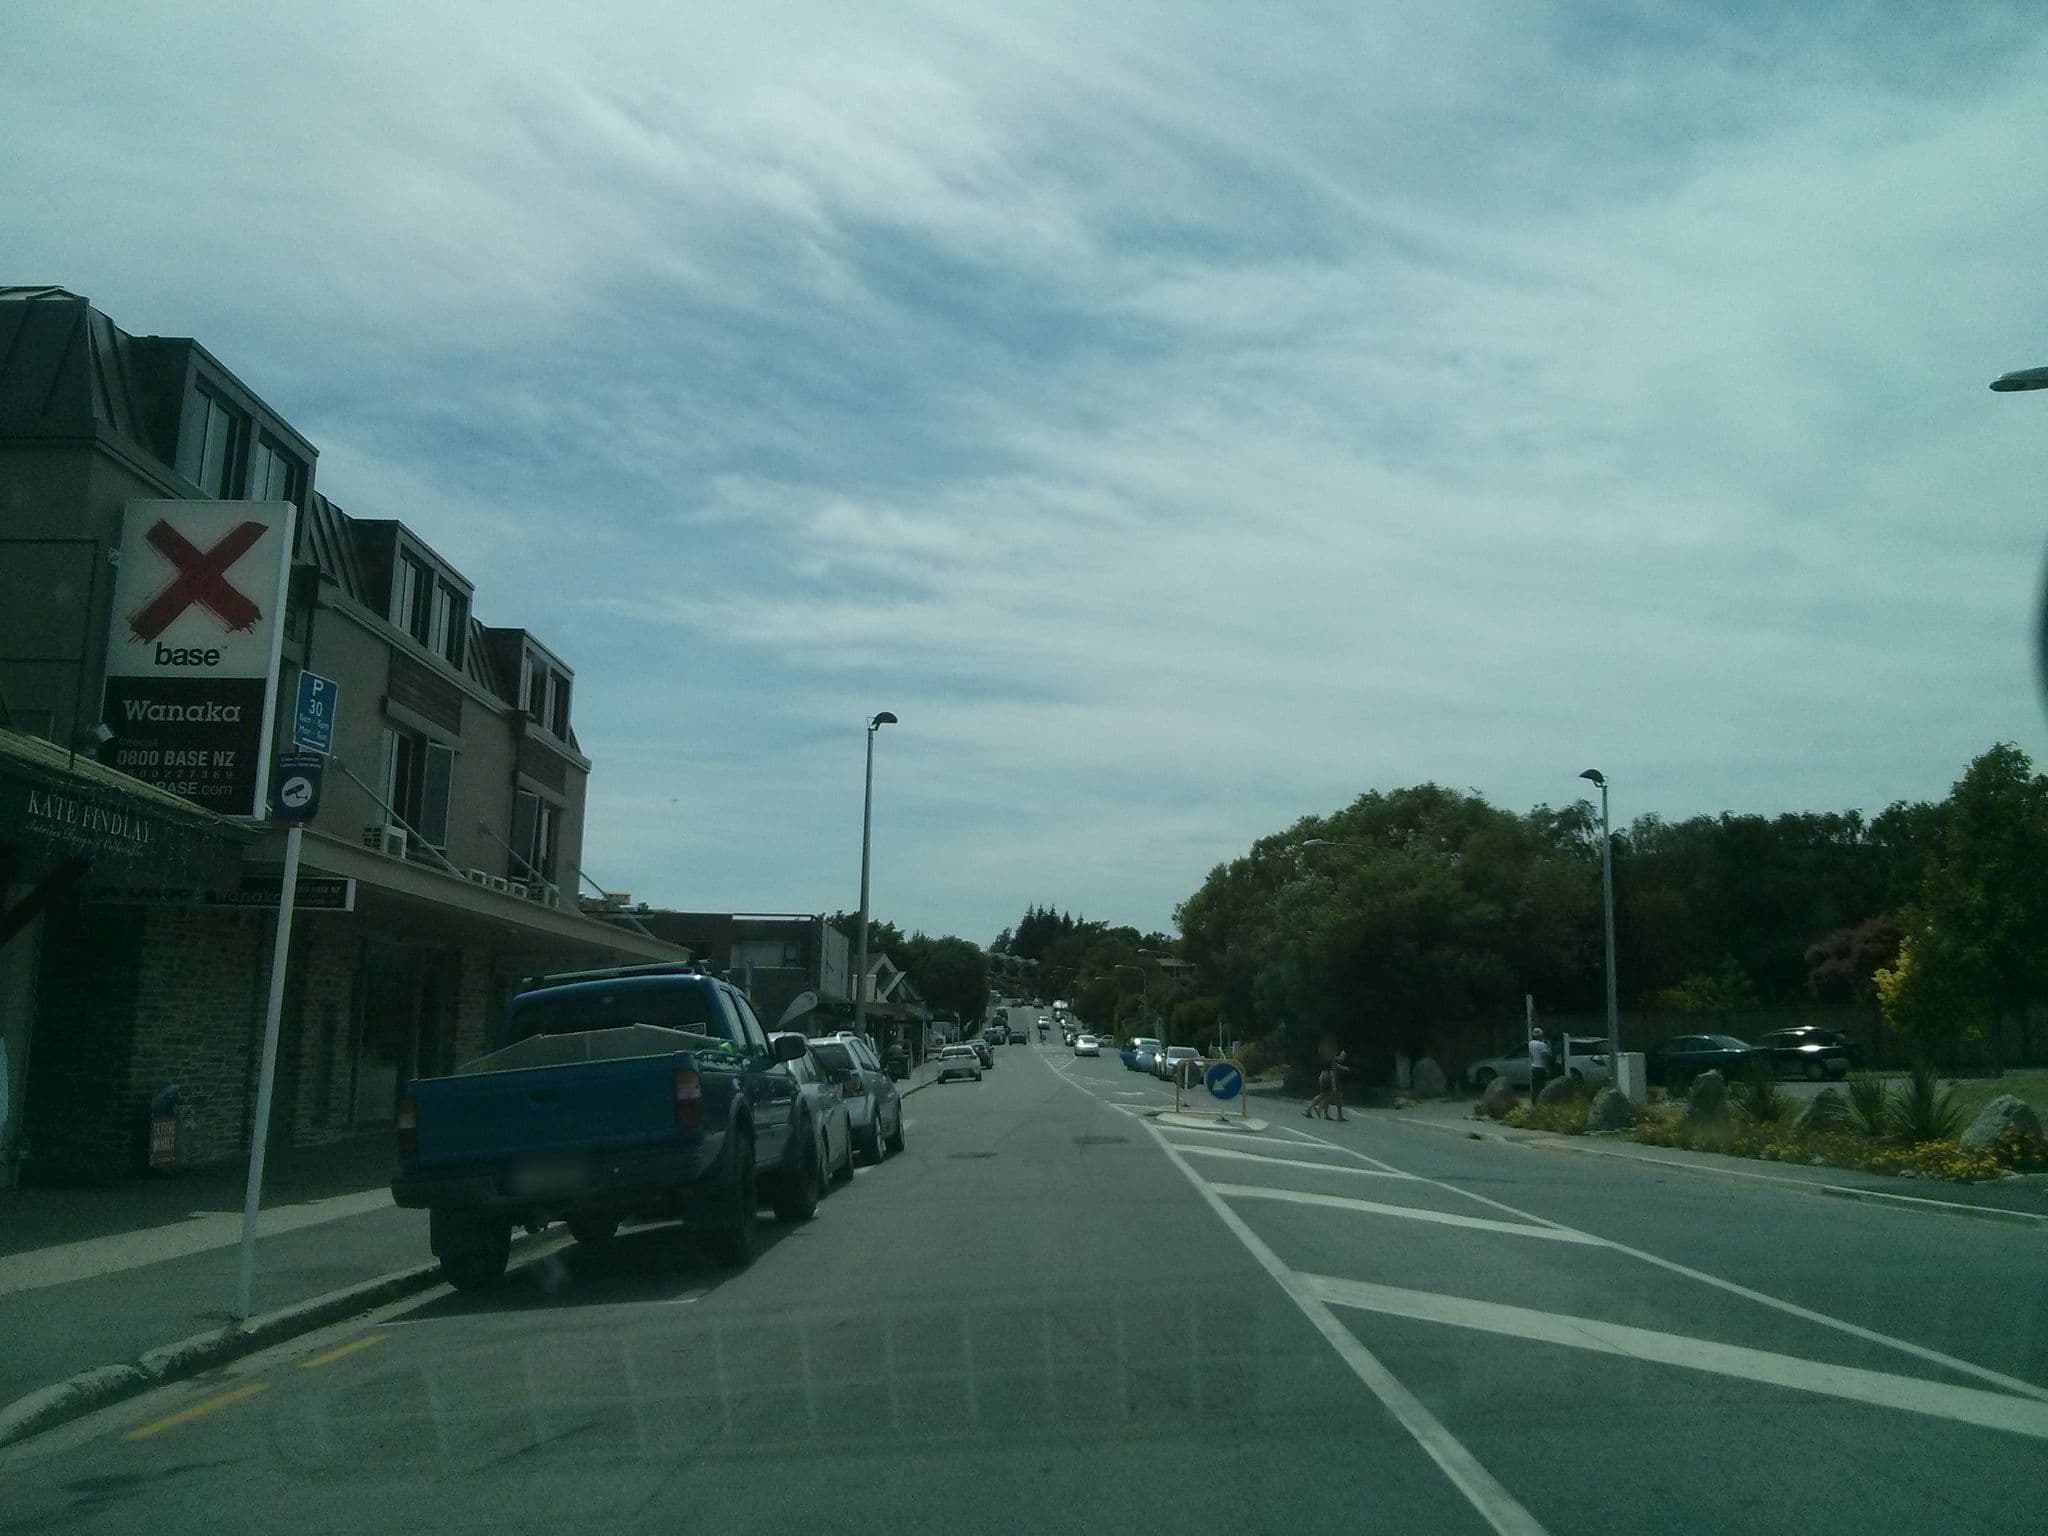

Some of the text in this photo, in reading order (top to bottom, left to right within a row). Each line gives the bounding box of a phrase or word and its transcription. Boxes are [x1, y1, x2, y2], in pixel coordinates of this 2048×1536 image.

[154, 641, 221, 666] base
[312, 678, 324, 697] P
[122, 699, 241, 722] Wanaka
[308, 698, 324, 717] 30
[117, 750, 236, 767] 0800 BASE NZ
[152, 781, 233, 797] BASE.com
[28, 790, 77, 824] KATE
[81, 804, 153, 844] FINDLAY
